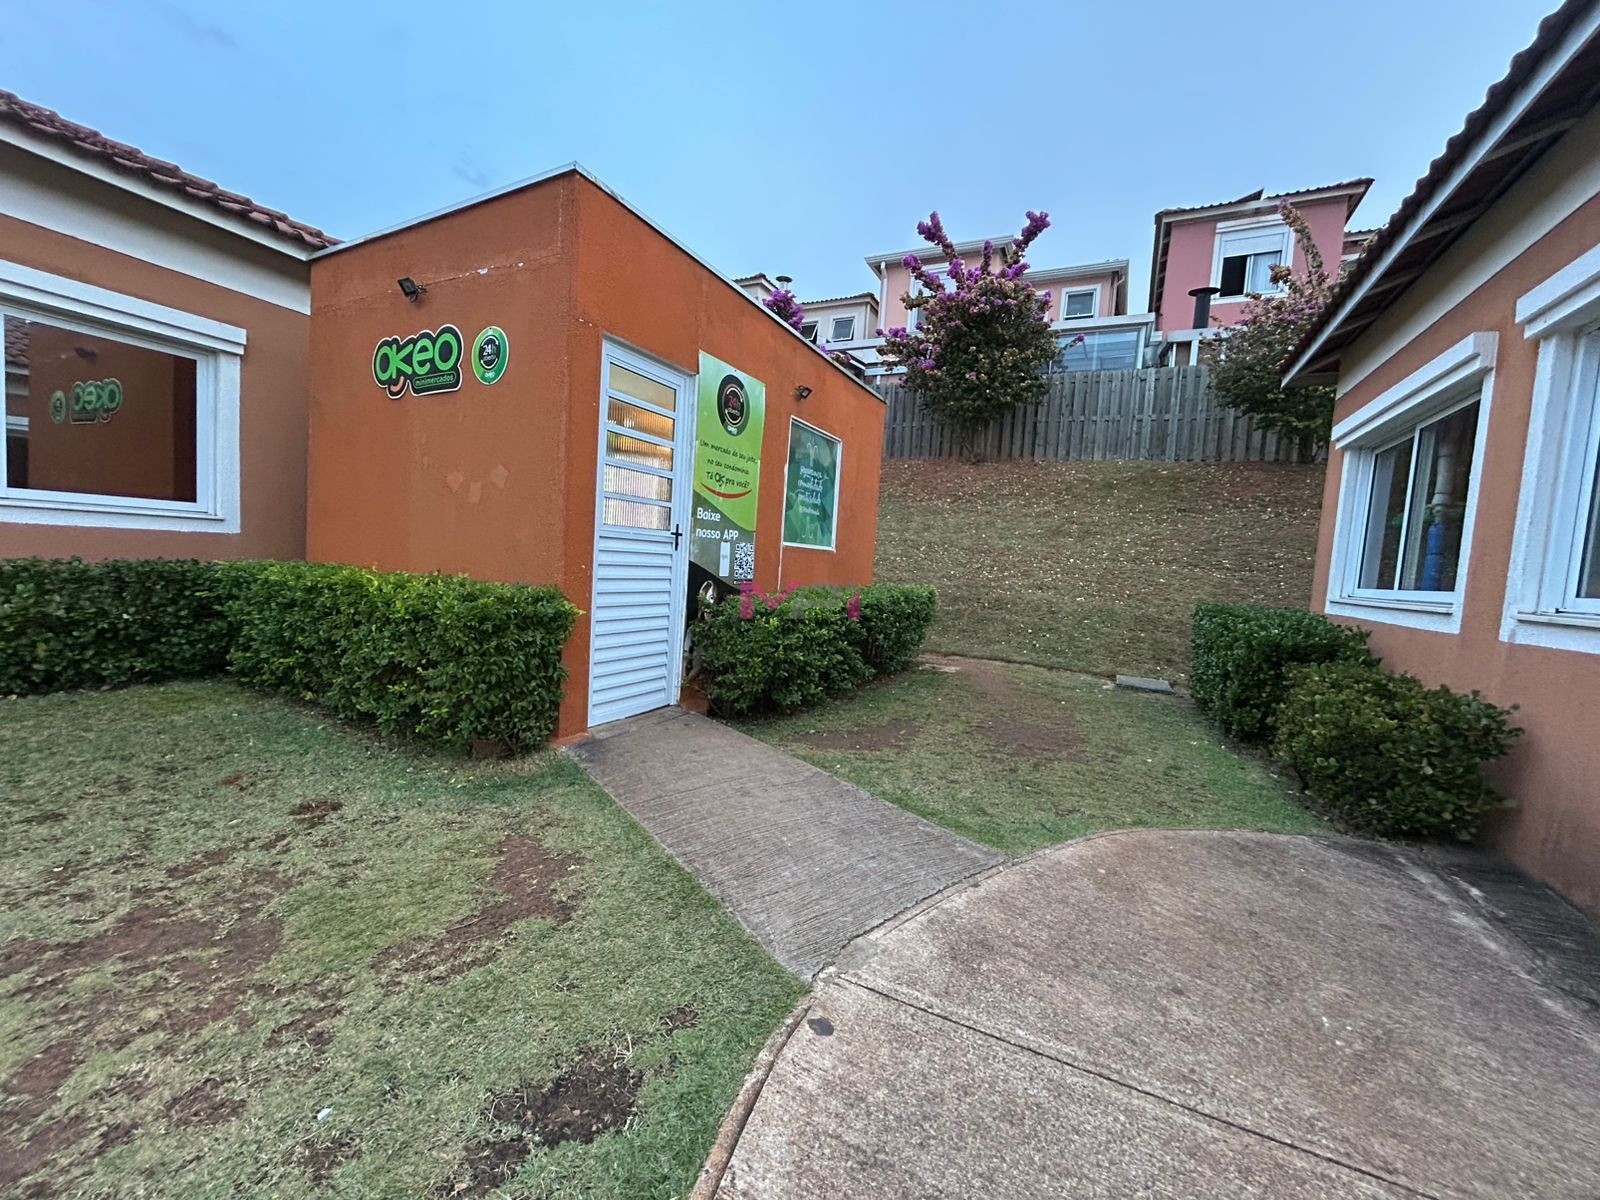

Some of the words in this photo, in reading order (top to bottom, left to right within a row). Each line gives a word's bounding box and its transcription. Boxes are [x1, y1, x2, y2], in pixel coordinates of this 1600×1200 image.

[710, 444, 731, 455] mercado
[696, 507, 721, 521] Baixe
[695, 528, 721, 539] nosso
[723, 529, 739, 540] APP
